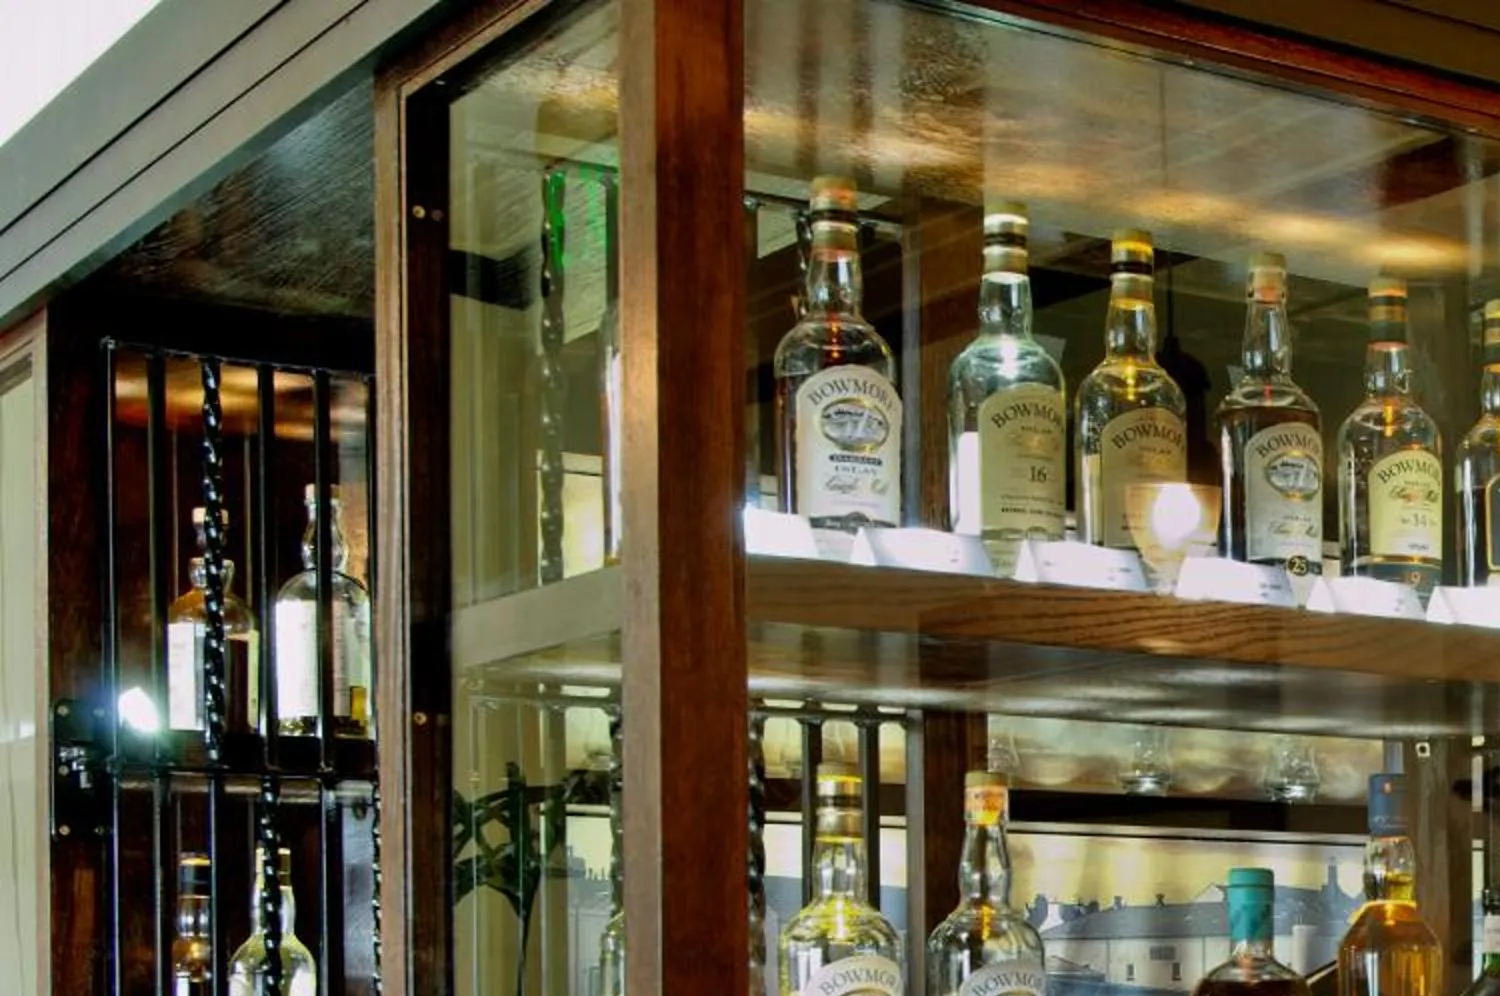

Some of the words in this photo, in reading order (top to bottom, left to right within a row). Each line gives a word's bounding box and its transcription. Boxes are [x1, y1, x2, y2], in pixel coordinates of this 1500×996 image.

[991, 402, 1065, 433] BOWMO
[1112, 423, 1185, 453] BOWMOR
[1255, 433, 1320, 459] BOWMO
[1377, 459, 1441, 487] BOWMO
[1291, 557, 1307, 574] 25
[819, 967, 897, 996] BOWMOR
